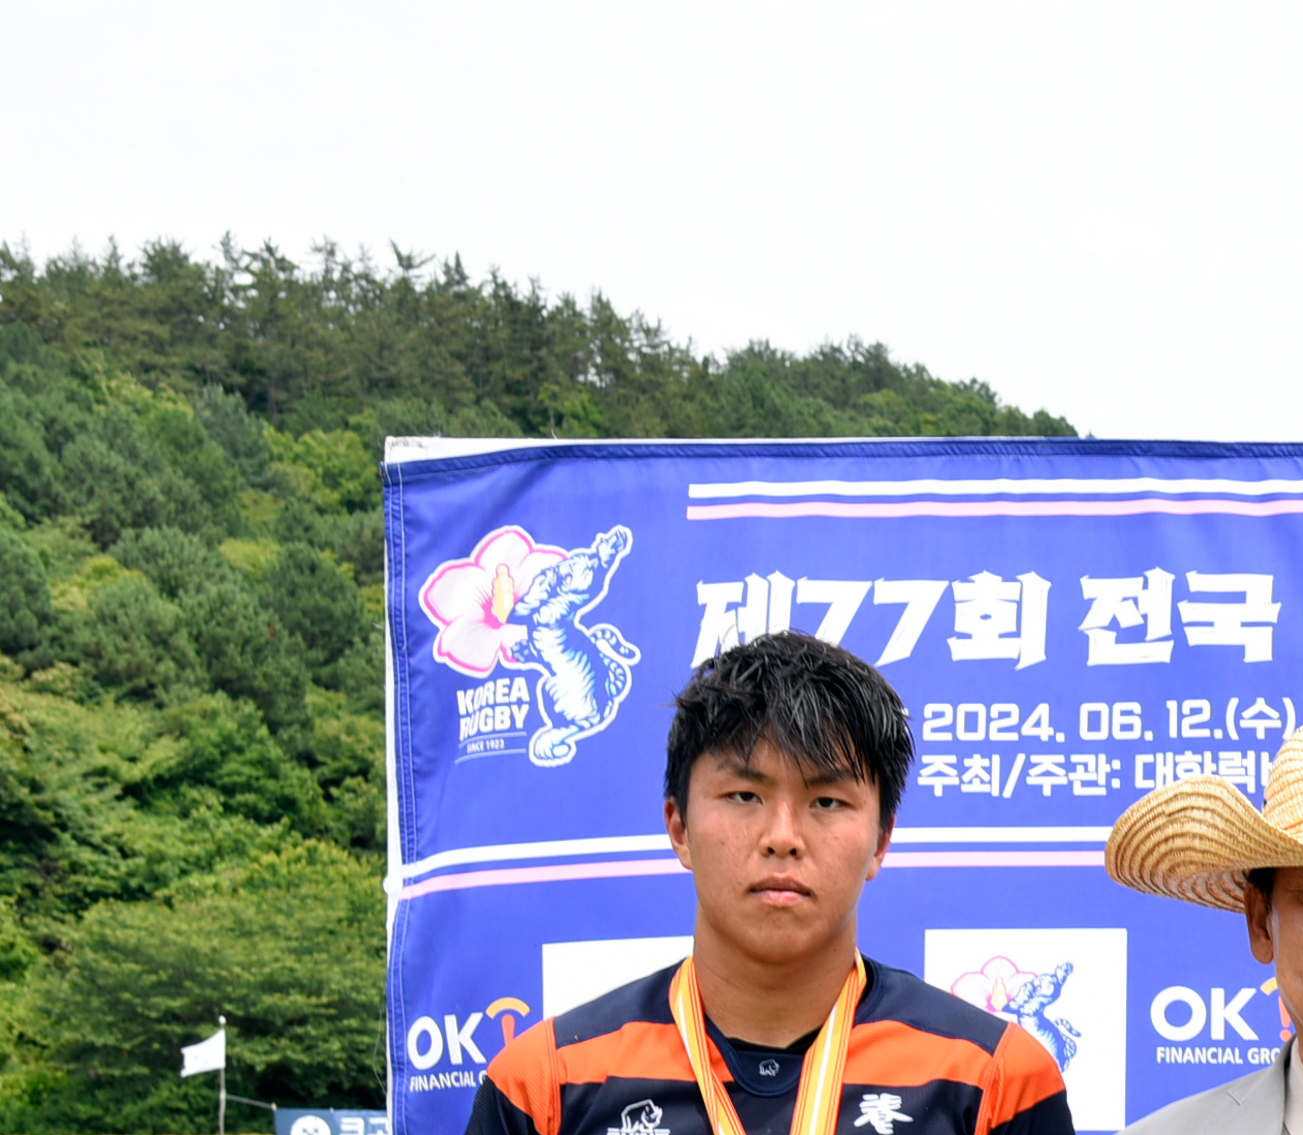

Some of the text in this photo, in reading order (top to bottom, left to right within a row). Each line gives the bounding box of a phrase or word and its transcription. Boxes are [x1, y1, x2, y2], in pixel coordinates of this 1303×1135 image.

[690, 570, 1051, 670] 제77회
[1078, 566, 1281, 667] 전국
[457, 677, 530, 715] KOREA
[459, 703, 530, 742] RUGBY
[922, 703, 1065, 742] 2024.
[1079, 702, 1153, 741] 06.
[1166, 697, 1297, 741] 12.(수)
[466, 738, 505, 754] SINCE 1923
[917, 752, 1122, 798] 주최/주관:
[1156, 1046, 1244, 1065] FINANCIAL
[409, 1070, 477, 1093] FINANCIAL
